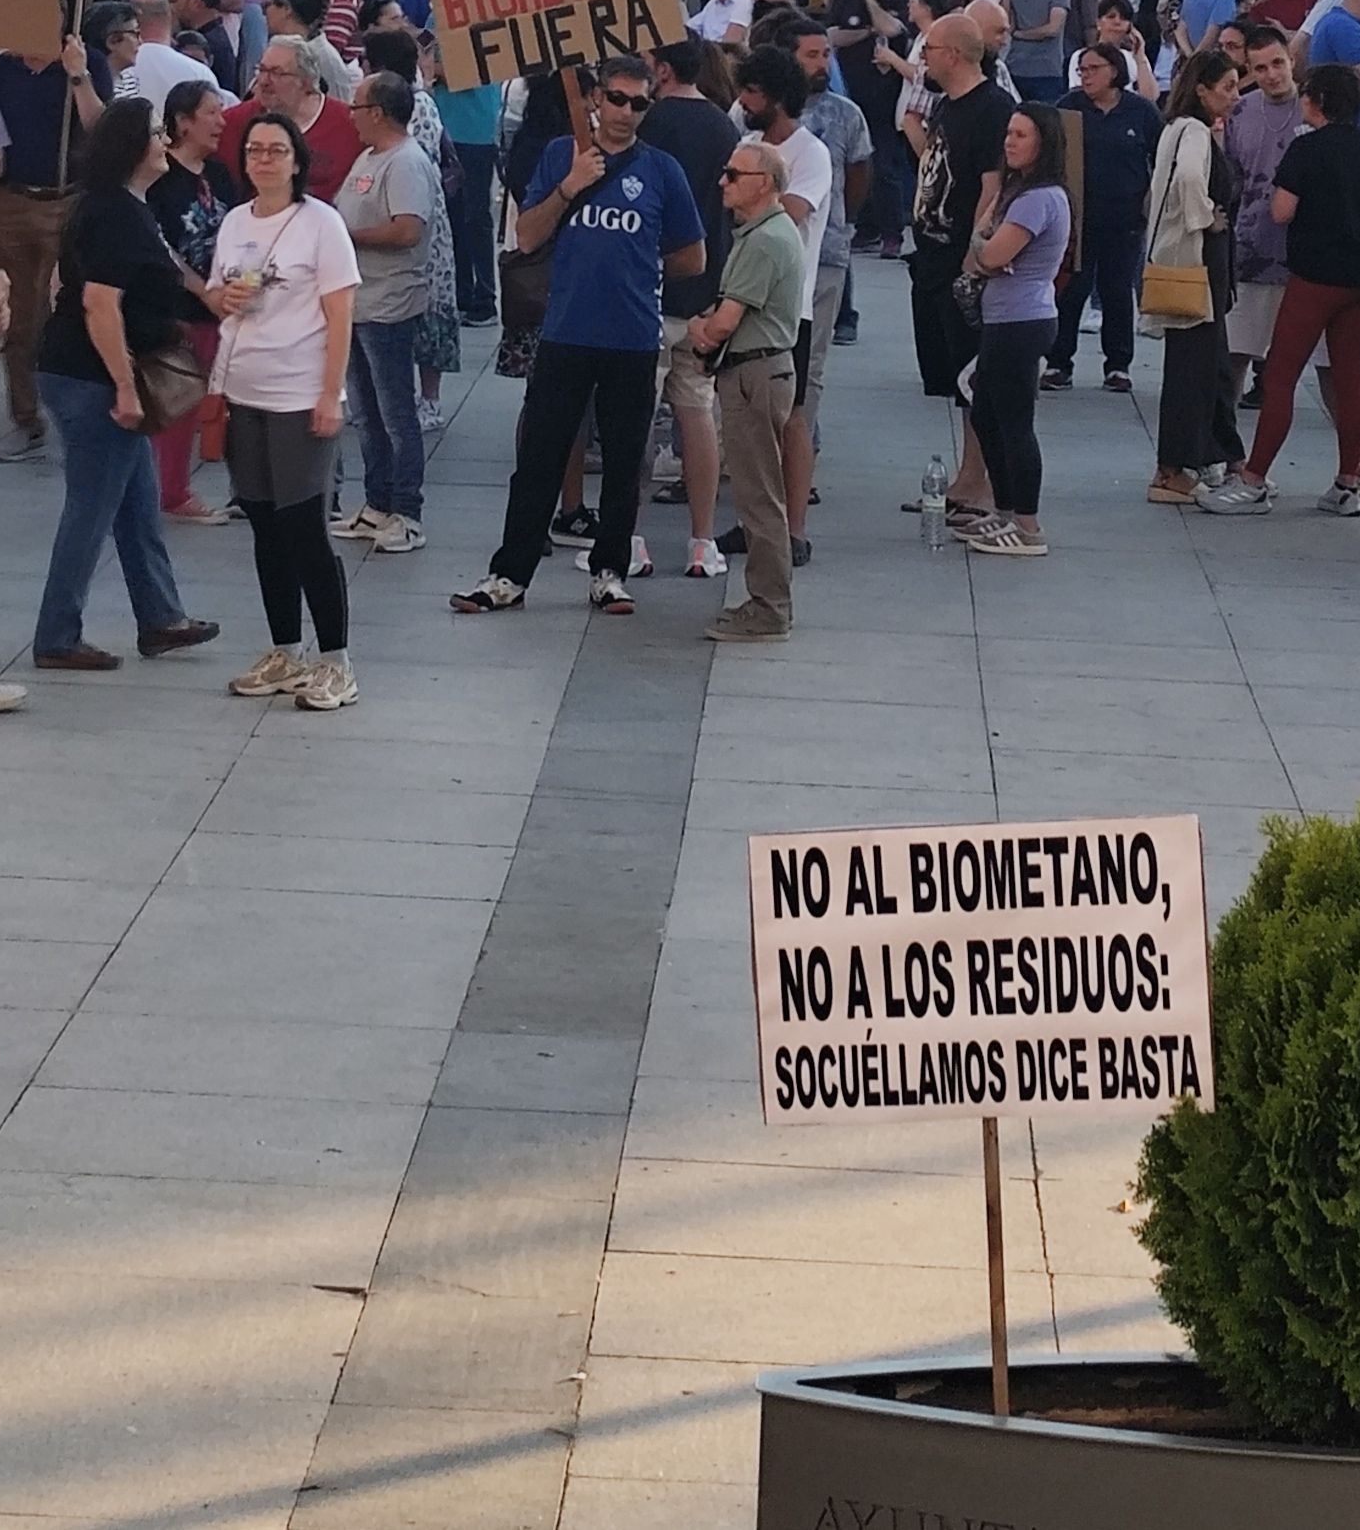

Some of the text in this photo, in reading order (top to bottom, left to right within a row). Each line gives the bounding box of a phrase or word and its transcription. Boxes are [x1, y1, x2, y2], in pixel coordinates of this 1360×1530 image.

[771, 832, 1172, 921] NO AL BIOMETANO,
[779, 933, 1171, 1021] NO A LOS RESIDUOS:
[775, 1028, 1201, 1110] SOCUÉLLAMOS DICE BASTA
